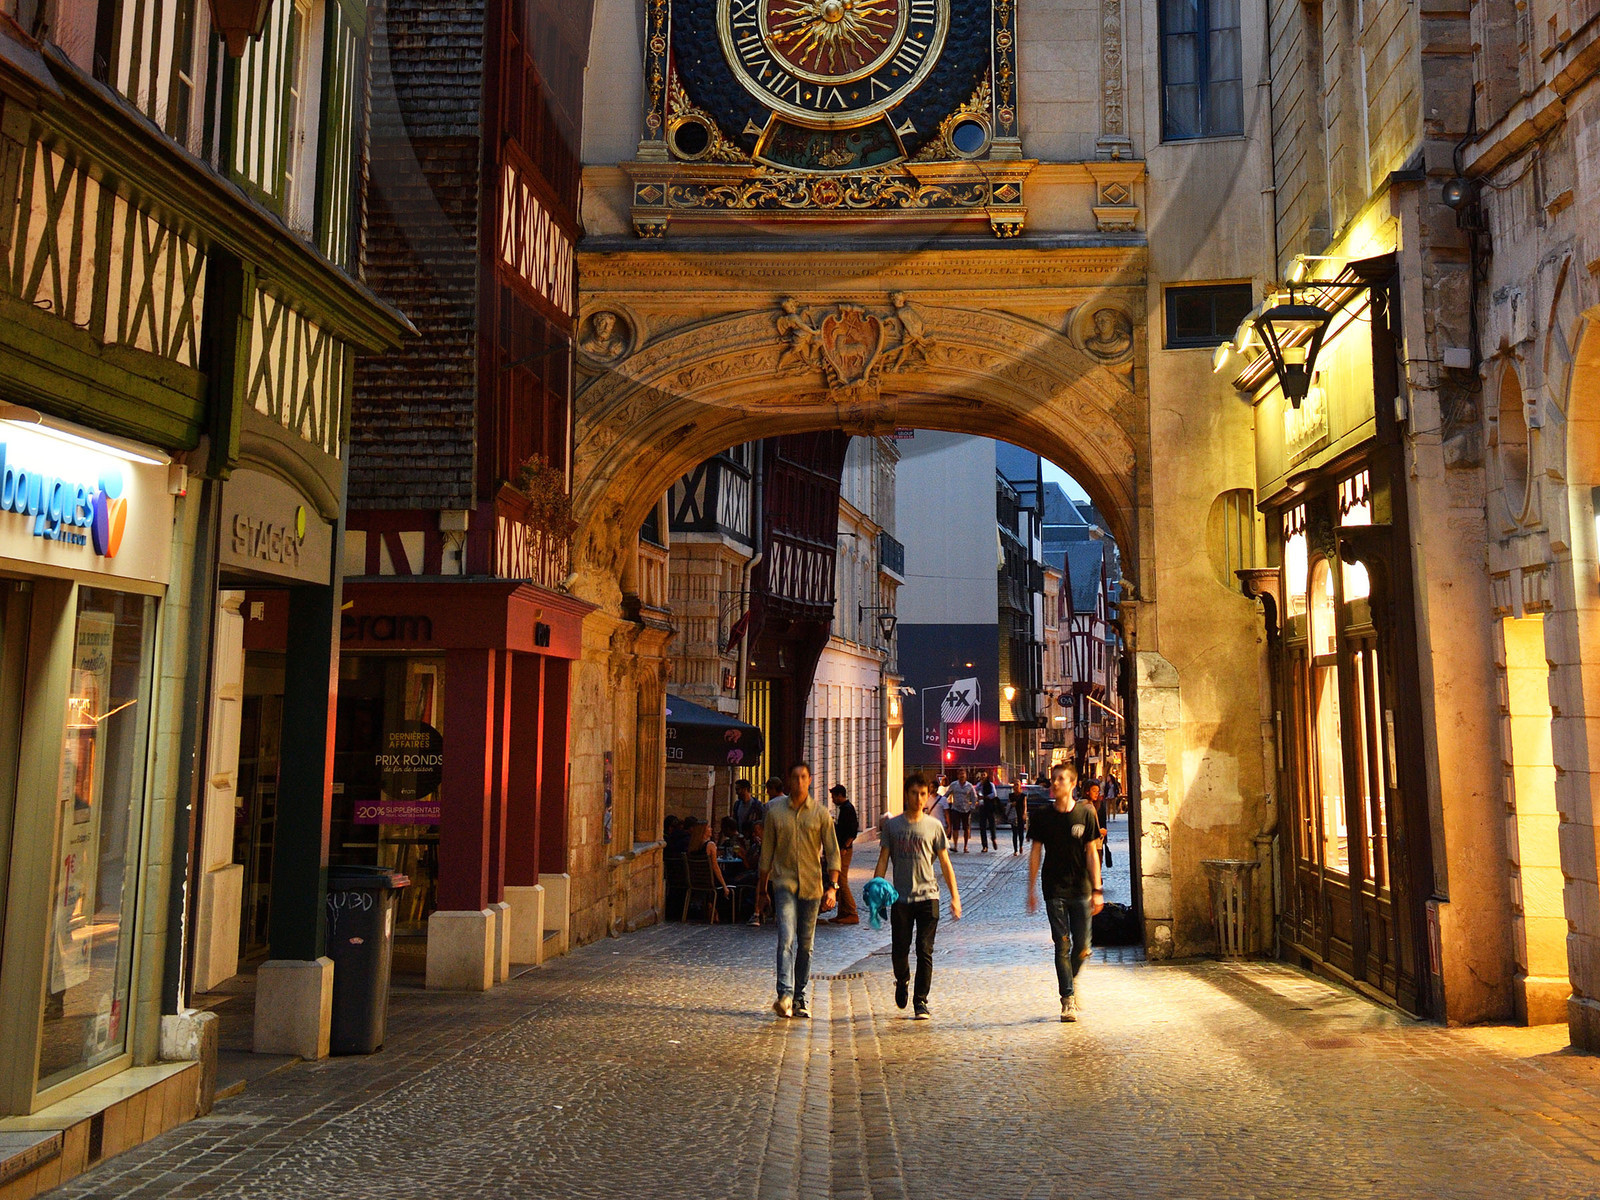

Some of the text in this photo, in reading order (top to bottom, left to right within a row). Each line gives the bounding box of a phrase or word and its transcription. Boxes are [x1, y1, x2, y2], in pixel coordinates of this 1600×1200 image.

[911, 0, 935, 25] III
[737, 33, 771, 80] VIII
[892, 37, 927, 74] IIII
[766, 75, 802, 105] VII
[814, 86, 848, 110] VI
[869, 77, 892, 100] V
[0, 442, 94, 541] bouygues
[389, 731, 430, 740] DERNIÈRES
[925, 728, 972, 736] BAQUE
[925, 735, 973, 746] POPAIRE
[375, 755, 442, 766] PRIX RONDS
[357, 806, 385, 818] -20%
